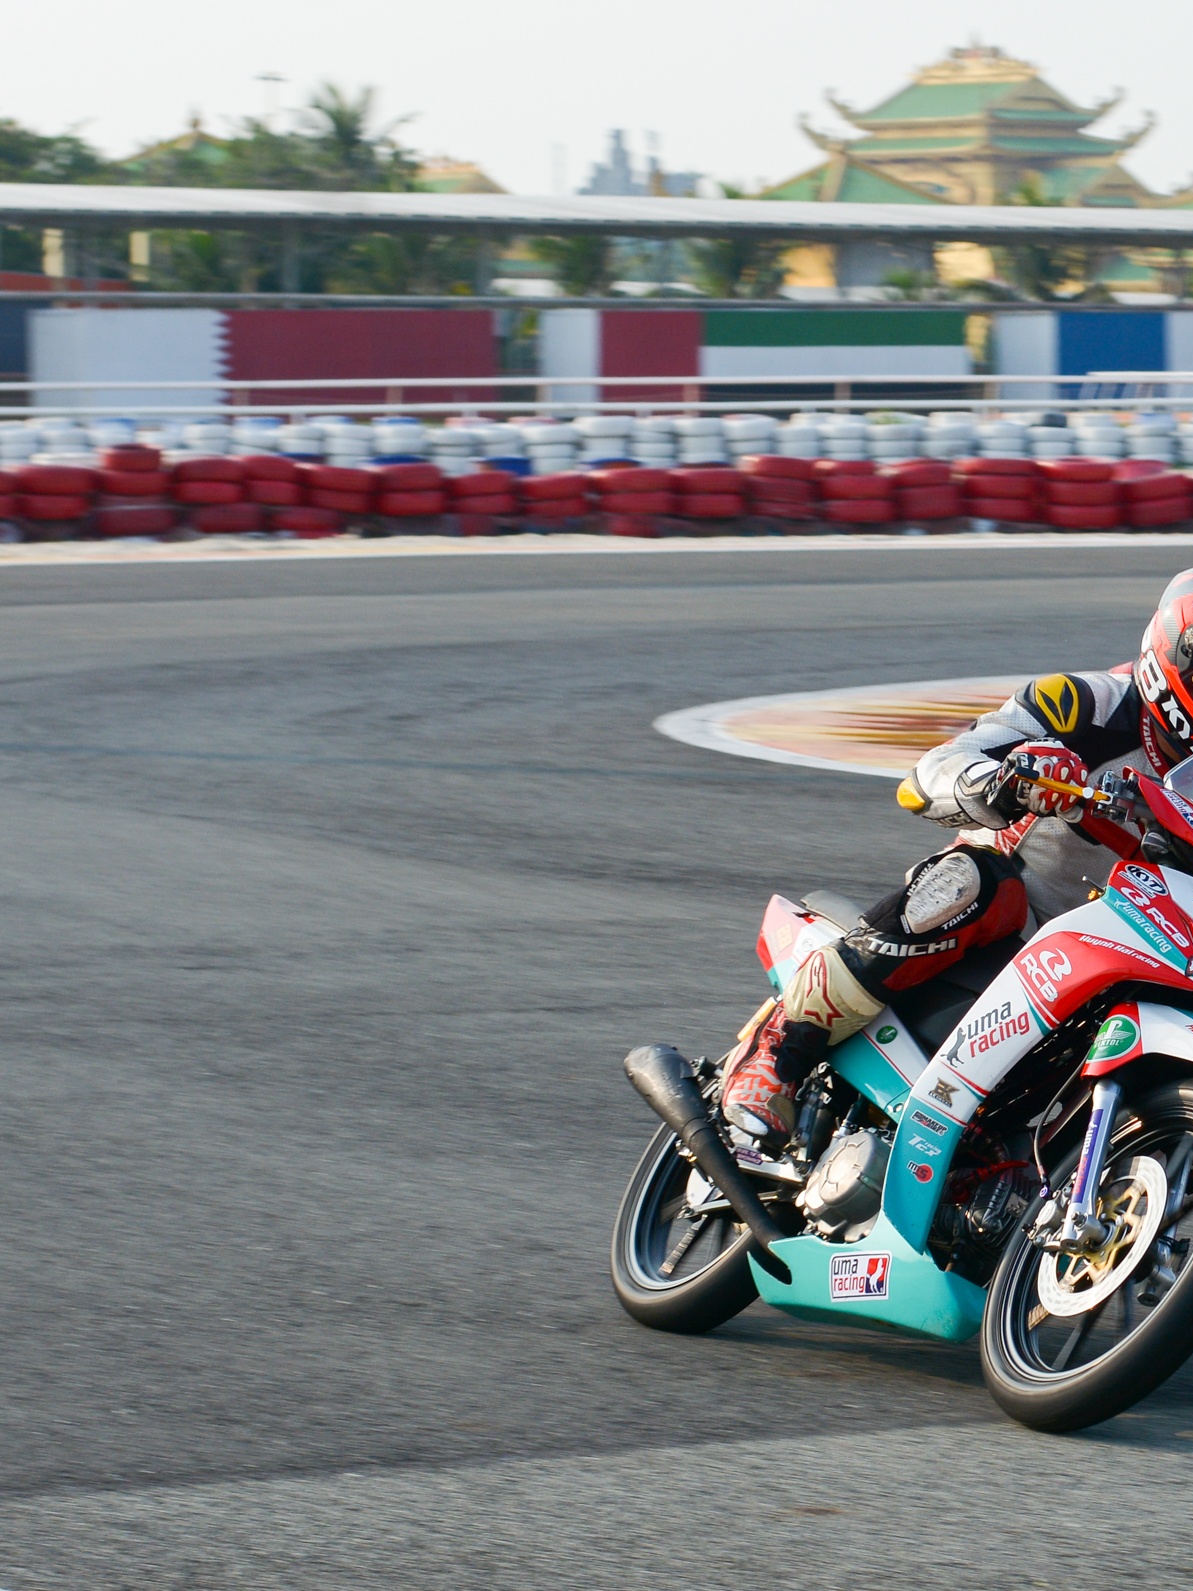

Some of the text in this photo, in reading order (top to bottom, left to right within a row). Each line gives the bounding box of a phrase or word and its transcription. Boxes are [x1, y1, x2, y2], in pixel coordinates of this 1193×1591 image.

[1143, 716, 1162, 767] TAICHI
[1128, 866, 1166, 893] KYT
[941, 902, 979, 930] TAICHI
[1124, 902, 1172, 953] umaracing
[1146, 907, 1190, 948] RCB
[867, 937, 957, 957] TAICHI
[1019, 952, 1059, 1003] RCB
[967, 1001, 1012, 1040] uma
[969, 1011, 1030, 1058] racing
[1082, 1130, 1094, 1155] uma
[833, 1259, 858, 1275] uma
[834, 1275, 865, 1293] racing
